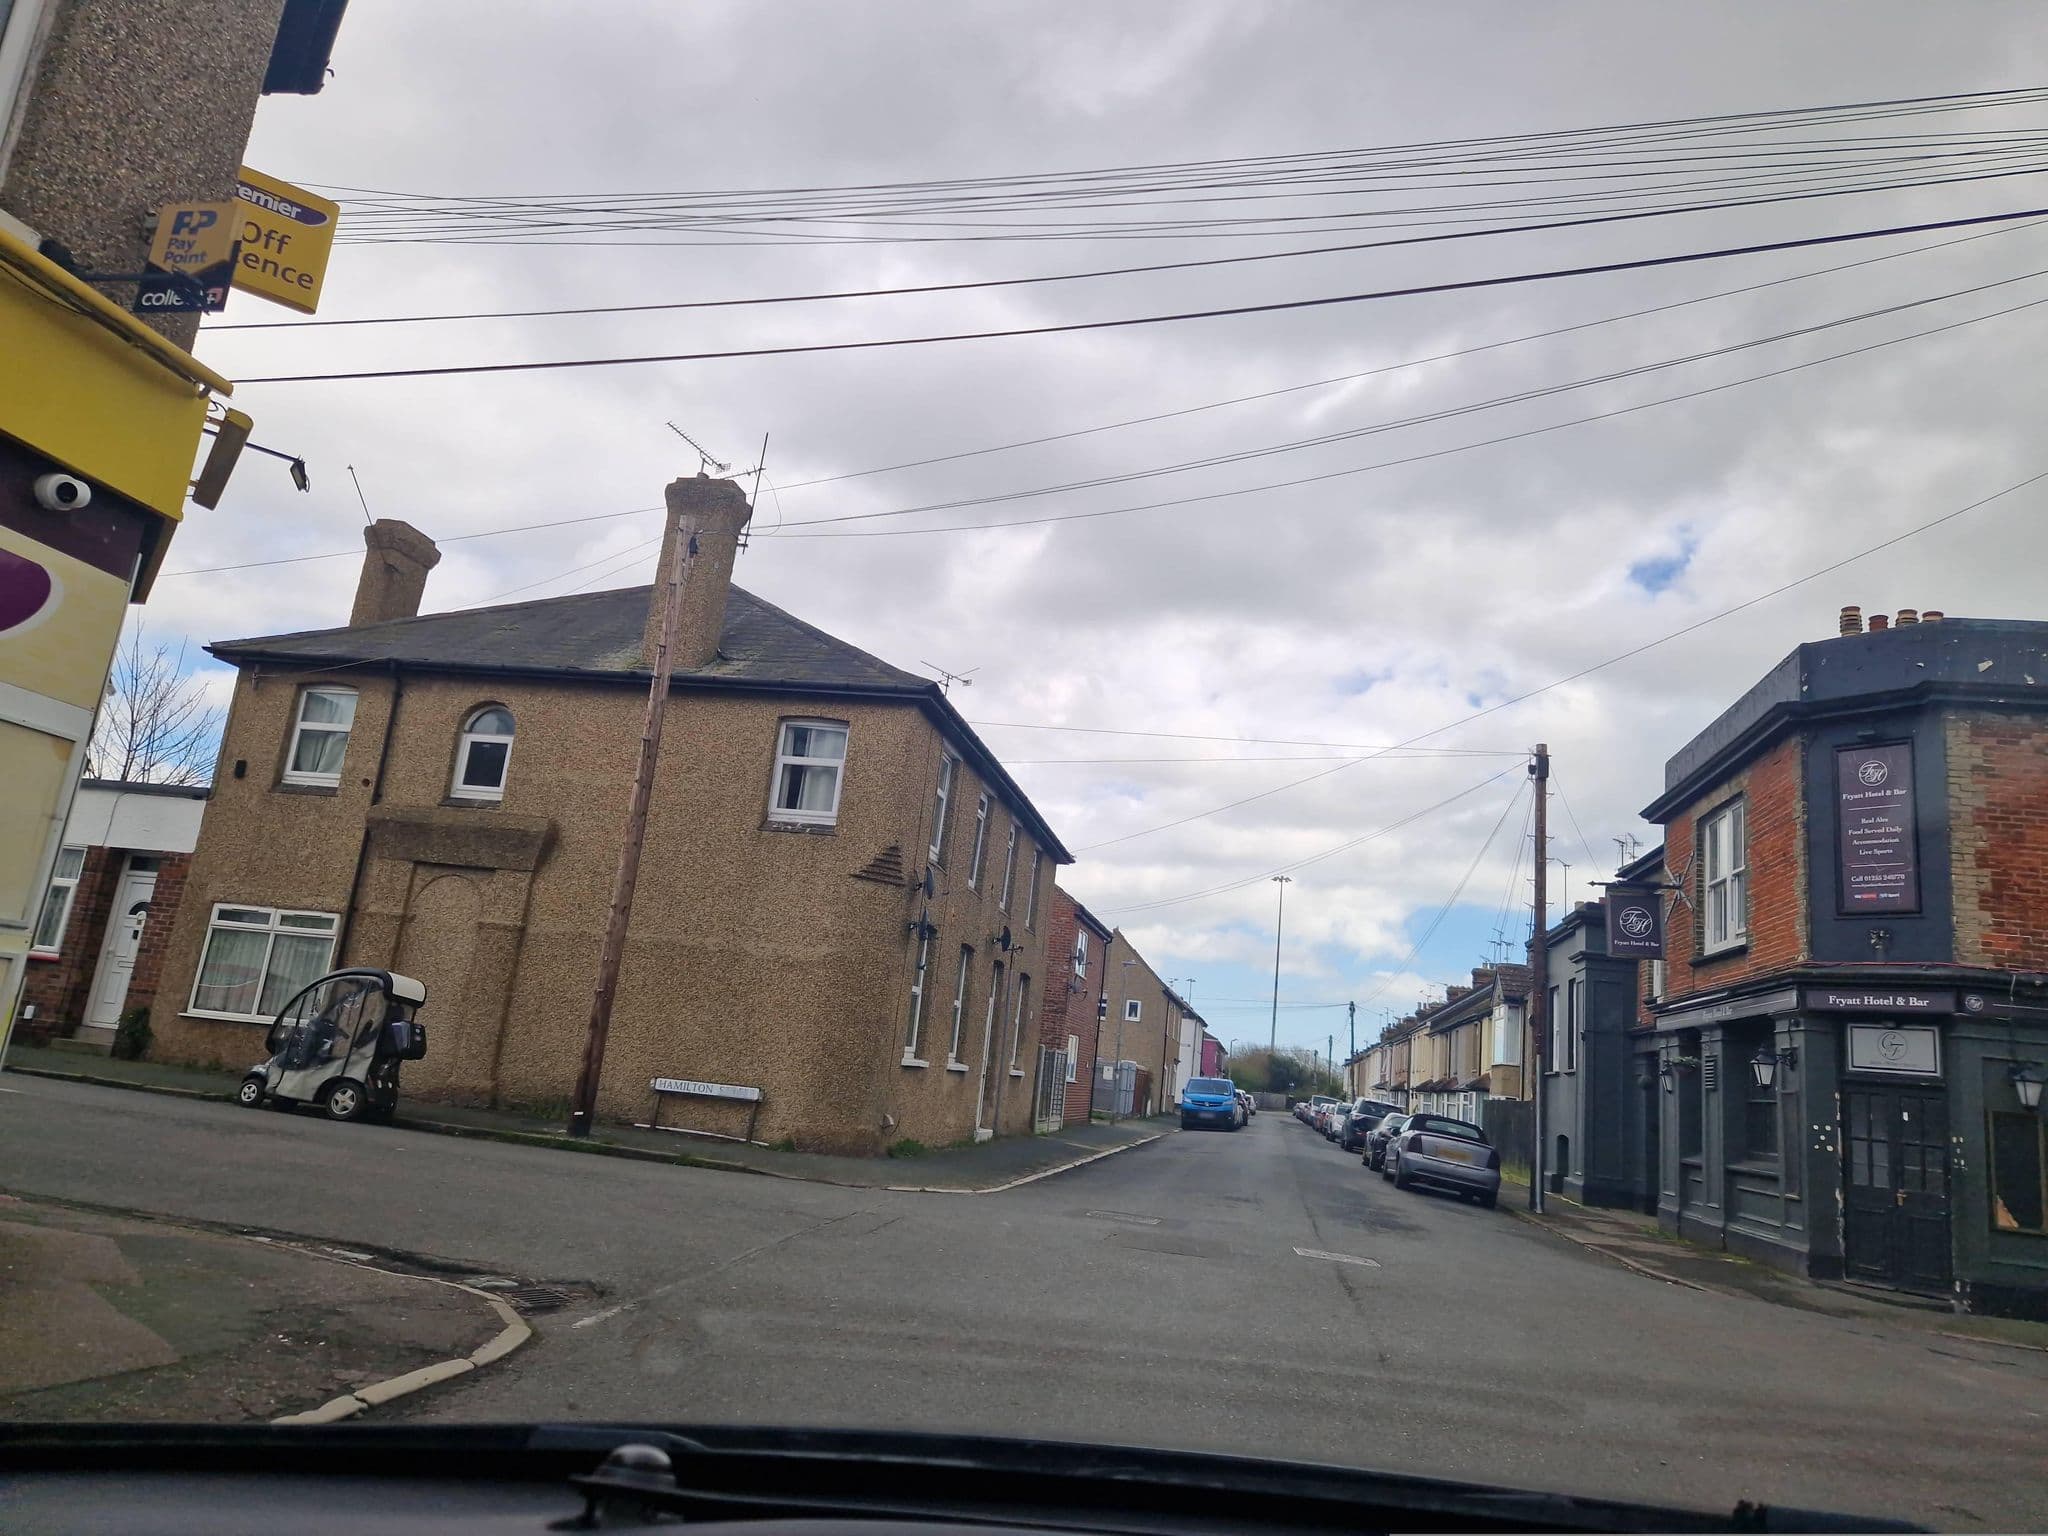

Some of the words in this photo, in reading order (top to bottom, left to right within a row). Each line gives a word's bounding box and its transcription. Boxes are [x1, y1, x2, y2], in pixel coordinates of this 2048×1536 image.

[236, 184, 302, 218] emier
[168, 237, 197, 253] Pay
[241, 220, 292, 255] Off
[163, 250, 208, 264] Point
[238, 249, 315, 290] ence
[1828, 995, 1861, 1007] Fryatt
[1863, 996, 1893, 1006] Hotel
[1895, 996, 1906, 1006] &
[1908, 996, 1930, 1007] Bar
[657, 1079, 714, 1094] HAMILTON
